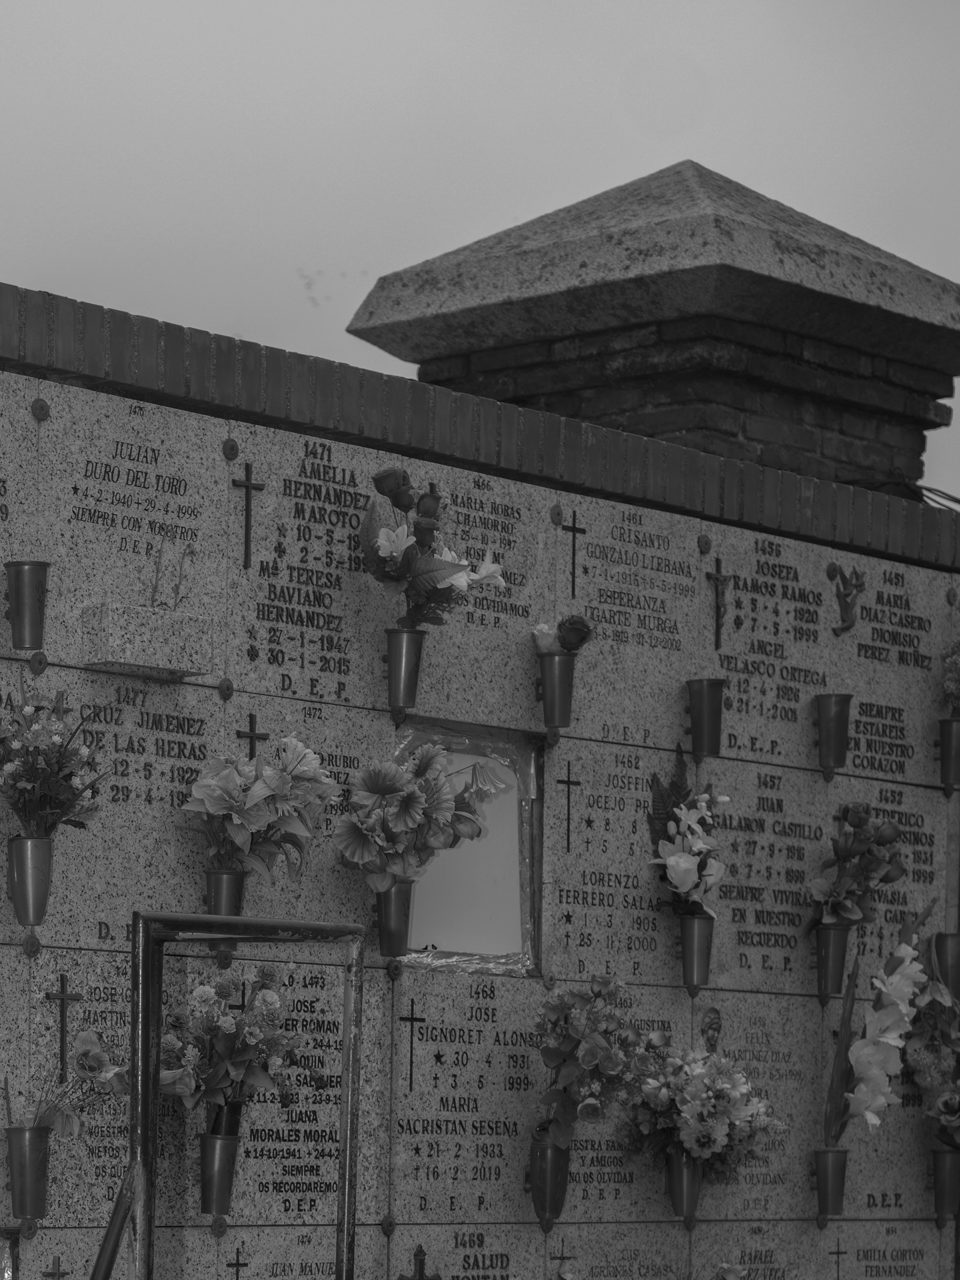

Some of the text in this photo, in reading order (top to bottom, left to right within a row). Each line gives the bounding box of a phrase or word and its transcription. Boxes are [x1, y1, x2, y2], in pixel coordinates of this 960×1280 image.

[112, 441, 160, 466] JULIAN
[303, 440, 332, 463] 1471
[84, 460, 188, 497] DURO DEL TORO
[298, 460, 358, 488] AMELIA
[283, 478, 370, 512] HERNANDEZ
[293, 502, 360, 530] MAROTO
[450, 493, 521, 520] MARIA ROBAS
[70, 505, 199, 542] SIEMPRE CON NOSOTROS
[457, 511, 514, 535] CHAMORRO
[610, 524, 670, 551] CRISANTO
[586, 542, 639, 567] GONZALO
[287, 563, 343, 591] TERESA
[755, 560, 799, 583] JOSEFA
[268, 582, 333, 610] BAVIANO
[598, 588, 666, 613] ESPERANZA
[733, 575, 823, 606] RAMOS RAMOS
[876, 590, 911, 611] MARIA
[255, 602, 344, 634] HERNANDEZ
[637, 613, 679, 635] MURGA
[860, 605, 932, 633] DIAZ CASERO
[871, 627, 920, 649] DIONISIO
[748, 639, 788, 660] ANGEL
[857, 643, 933, 671] PEREZ NUÑEZ
[719, 653, 827, 688] VELASCO ORTEGA
[79, 703, 206, 737] CRUZ JIMENEZ
[302, 707, 323, 720] 1472
[858, 702, 905, 723] SIEMPRE
[855, 719, 906, 740] ESTAREIS
[82, 729, 207, 761] DE LAS HERAS
[866, 738, 915, 759] NUESTRO
[614, 753, 640, 770] 1462
[852, 753, 906, 775] CORAZON
[588, 793, 625, 812] OCEJO
[756, 796, 784, 814] JUAN
[772, 820, 823, 841] CASTILLO
[582, 870, 639, 890] LORENZO
[558, 889, 615, 908] FERRERO
[719, 884, 765, 902] SIEMPRE
[731, 907, 802, 928] EN NUESTRO
[302, 976, 326, 989] 1473
[469, 984, 495, 1000] 1468
[467, 1006, 497, 1023] JOSE
[418, 1026, 483, 1045] SIGNORET
[439, 1096, 479, 1113] MARIA
[285, 1110, 318, 1124] JUANA
[397, 1118, 467, 1136] SACRISTAN
[249, 1129, 300, 1143] MORALES
[281, 1165, 320, 1177] SIEMPRE
[589, 1156, 624, 1168] AMIGOS
[272, 1182, 338, 1193] RECORDAREMO
[596, 1172, 634, 1184] OLVIDAN
[453, 1232, 484, 1249] 1469
[269, 1262, 294, 1277] JUAN
[462, 1254, 510, 1271] SALUD
